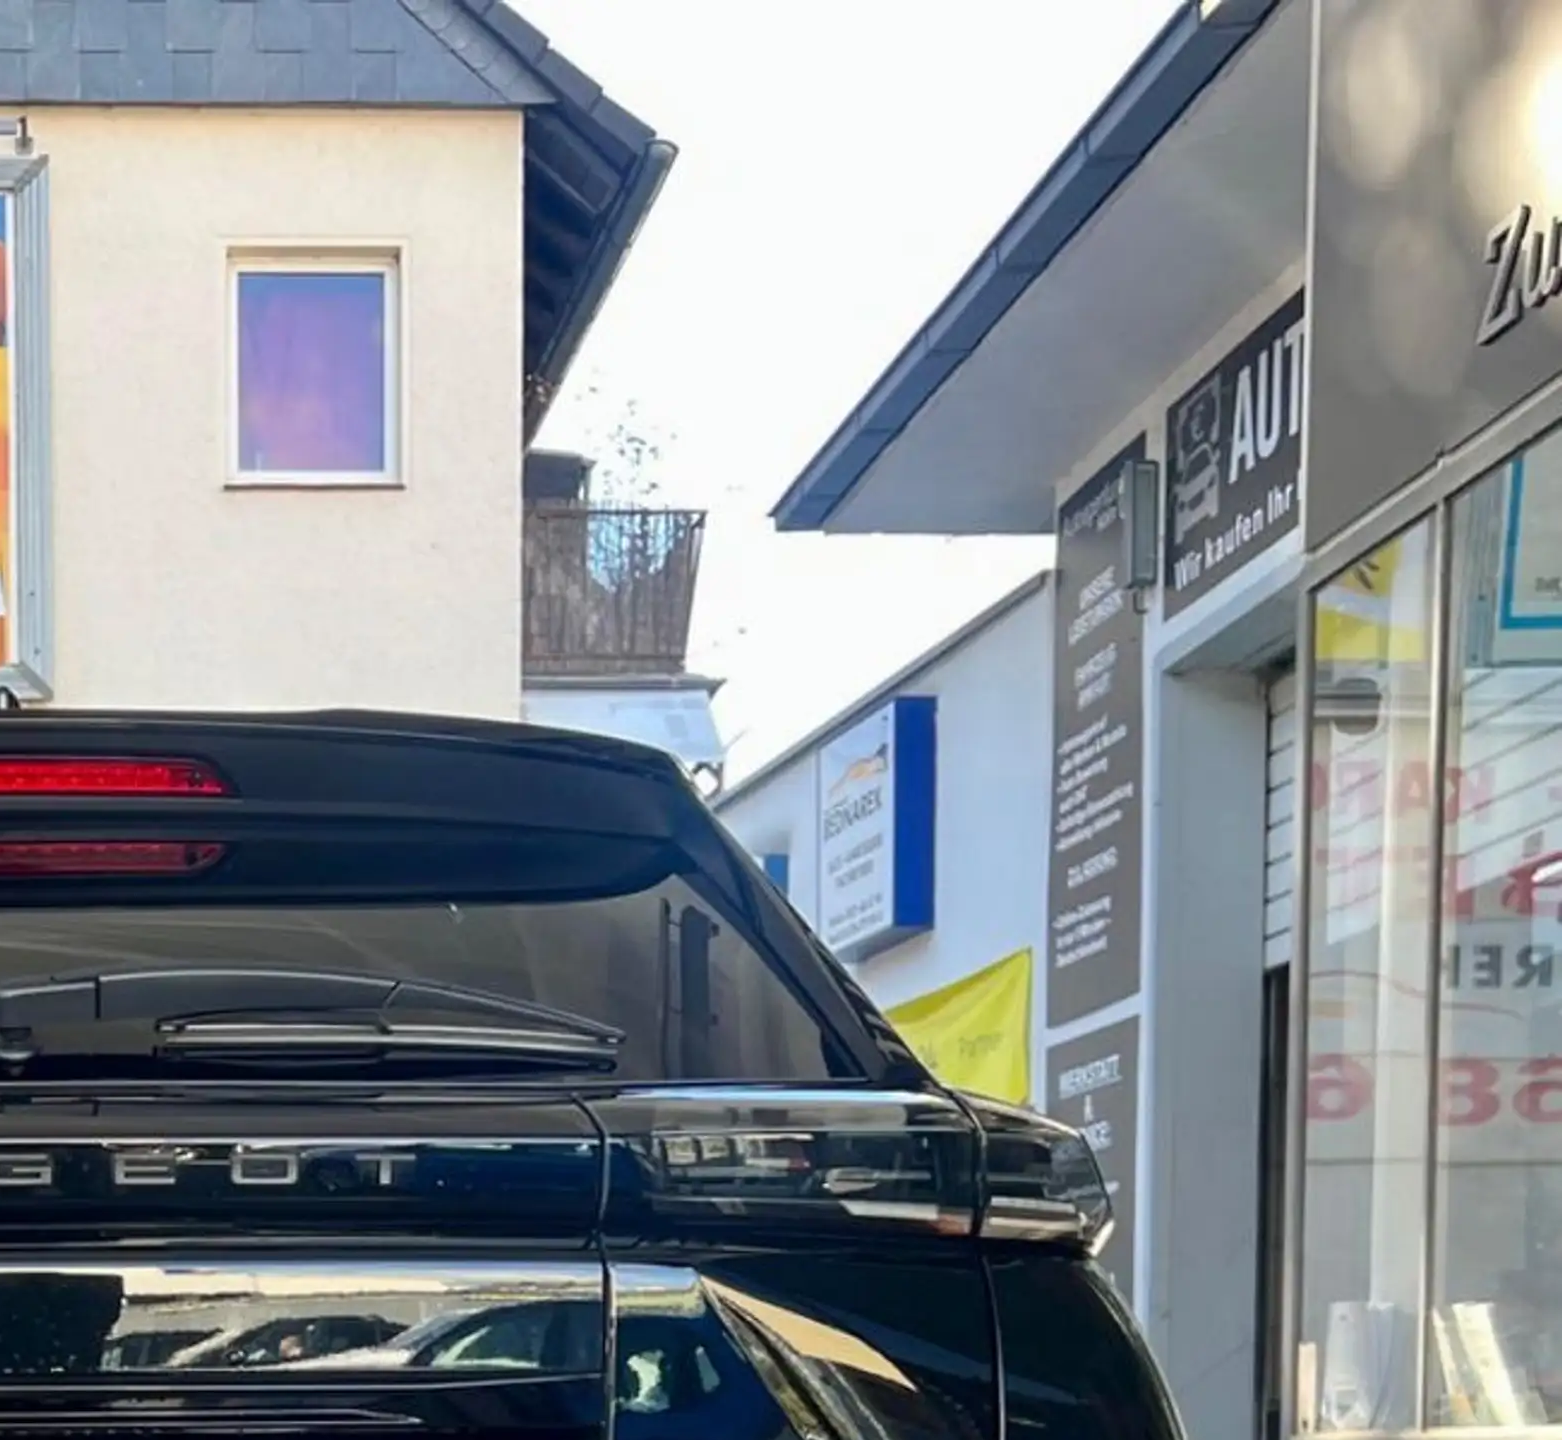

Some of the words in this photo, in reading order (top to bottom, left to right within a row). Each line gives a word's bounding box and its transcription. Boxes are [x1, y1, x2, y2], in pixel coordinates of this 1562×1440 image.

[1173, 551, 1203, 591] Wir
[1204, 506, 1264, 569] kaufen
[1267, 483, 1294, 524] Ihr
